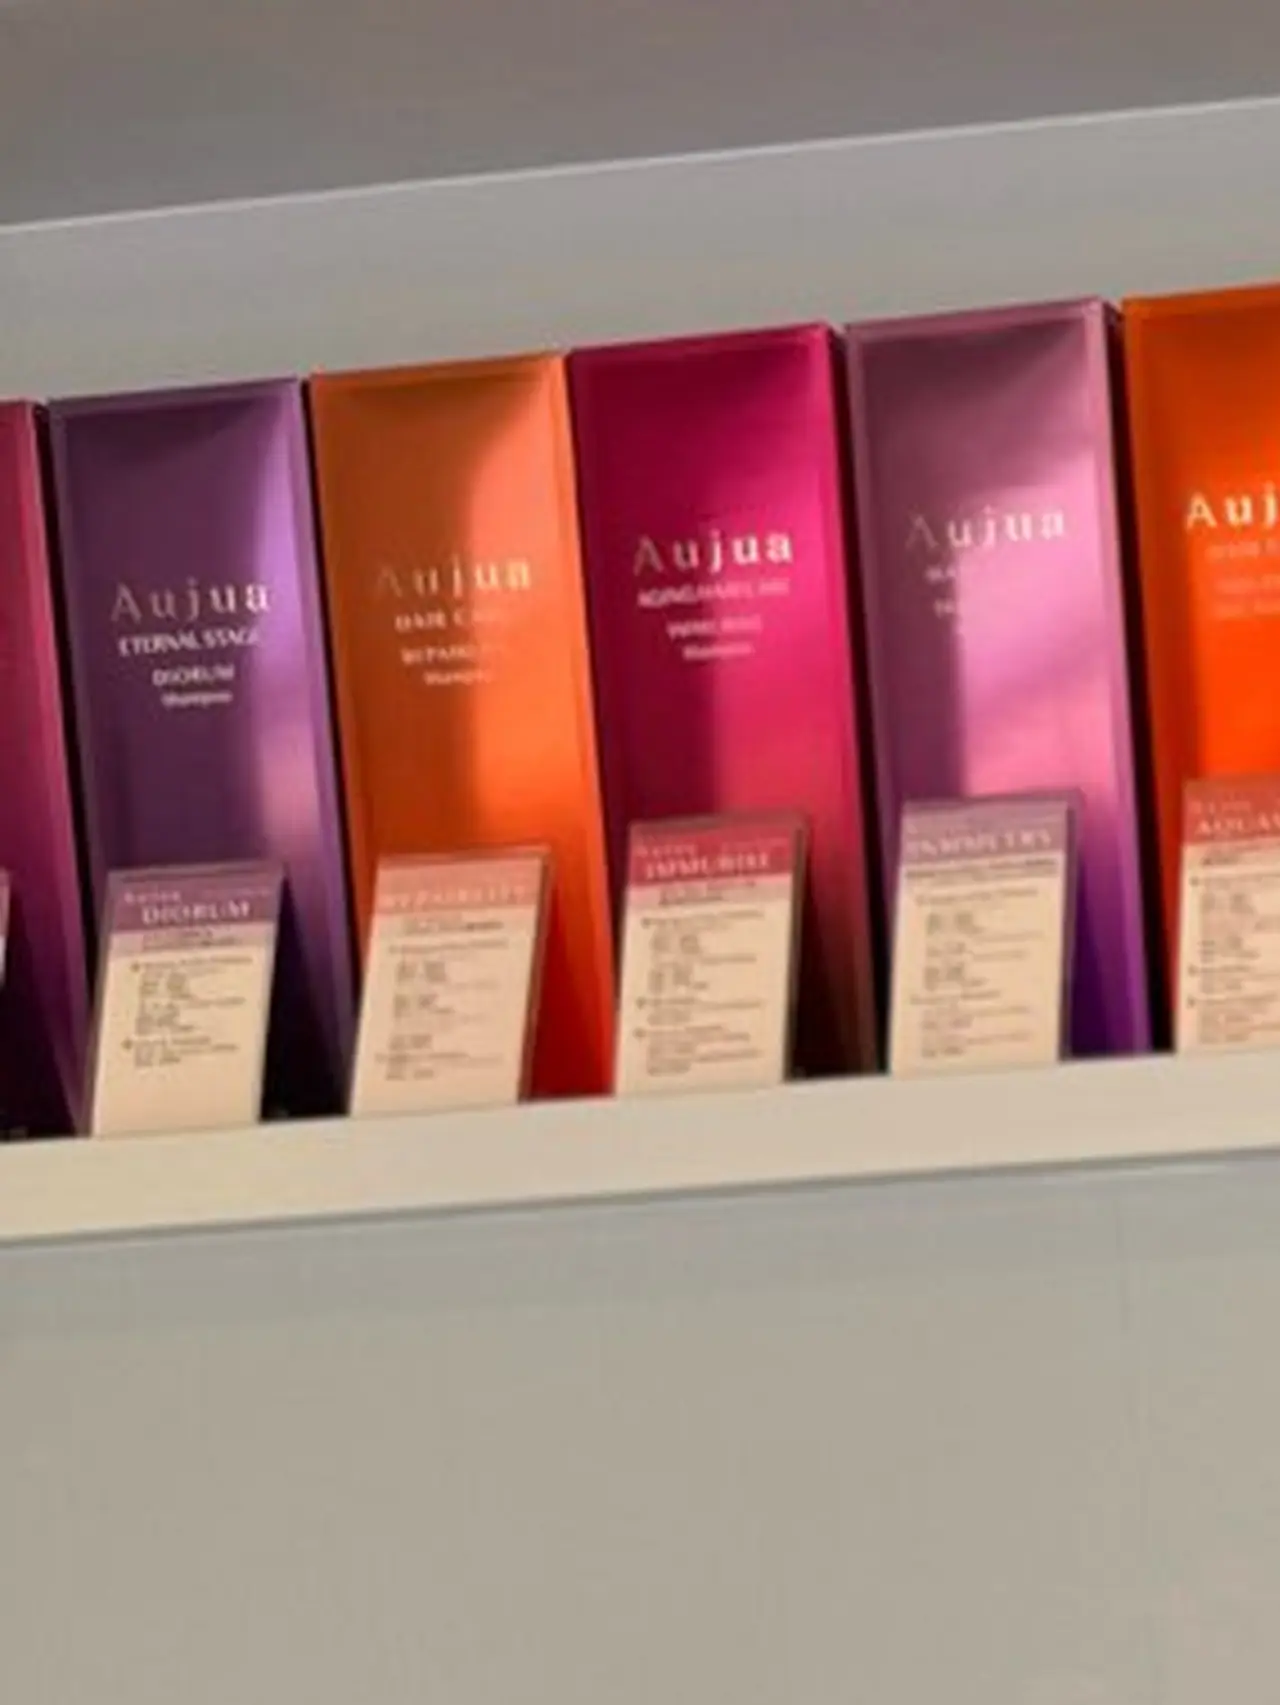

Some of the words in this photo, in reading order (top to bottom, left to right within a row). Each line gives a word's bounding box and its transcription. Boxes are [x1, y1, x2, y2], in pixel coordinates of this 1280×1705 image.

[904, 505, 1064, 549] Aujua
[633, 529, 793, 575] Aujua
[111, 576, 270, 624] Aujua
[374, 554, 531, 600] Aujua
